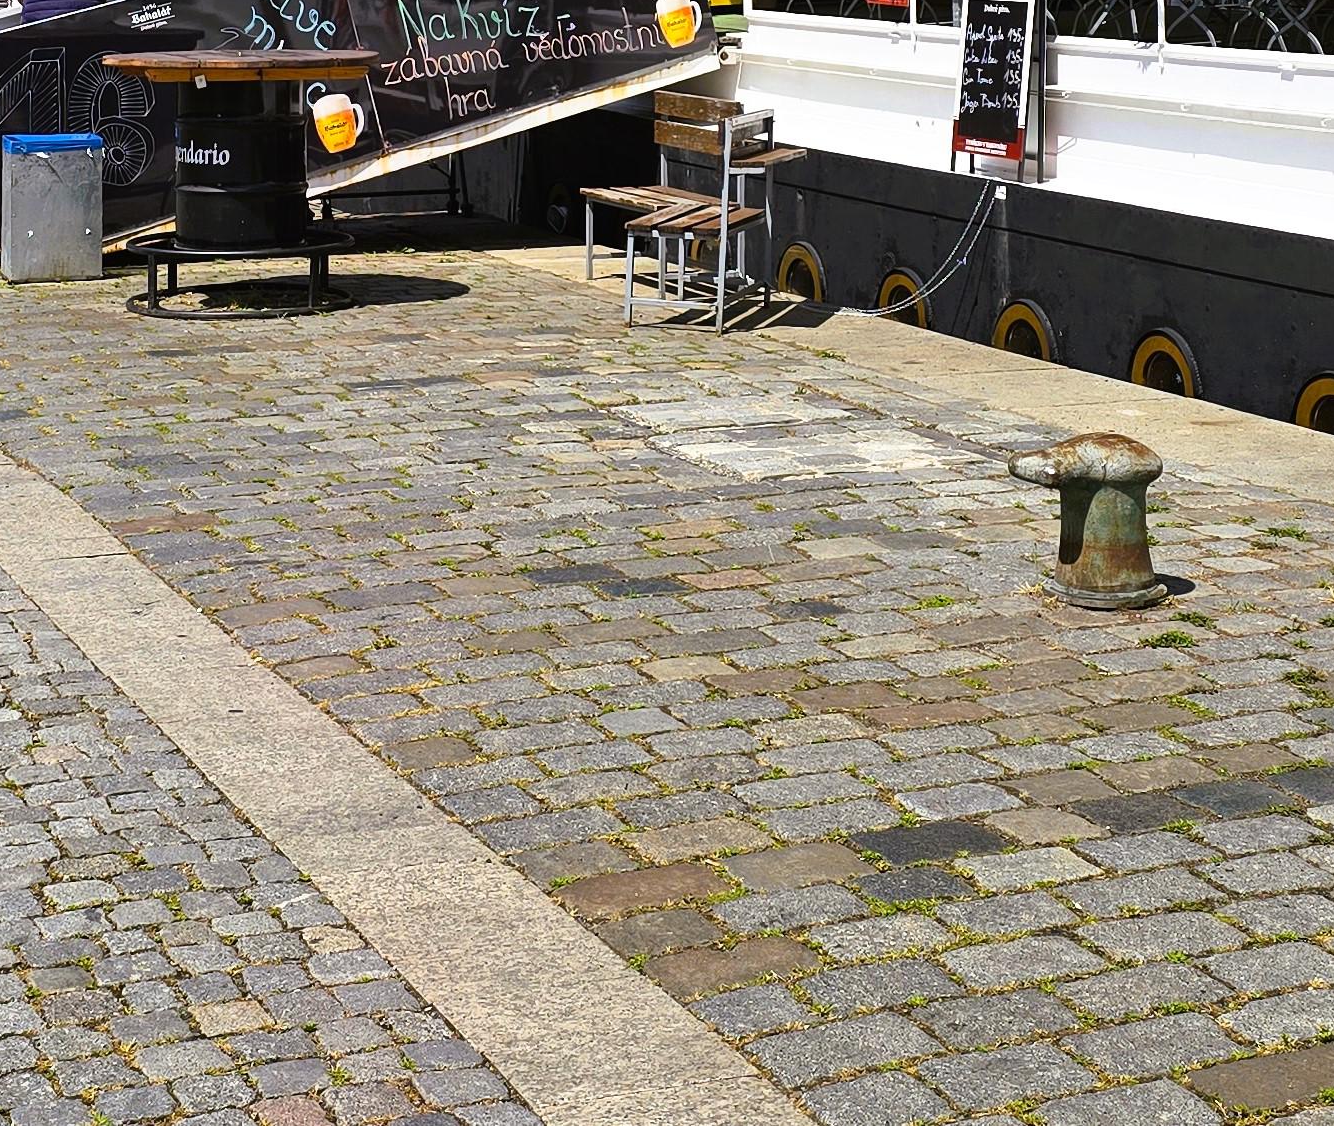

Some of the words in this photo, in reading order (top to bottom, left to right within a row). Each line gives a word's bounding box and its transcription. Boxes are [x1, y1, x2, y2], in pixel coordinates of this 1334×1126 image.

[380, 34, 510, 86] zábavná
[444, 76, 497, 121] hra
[175, 139, 231, 166] endario
